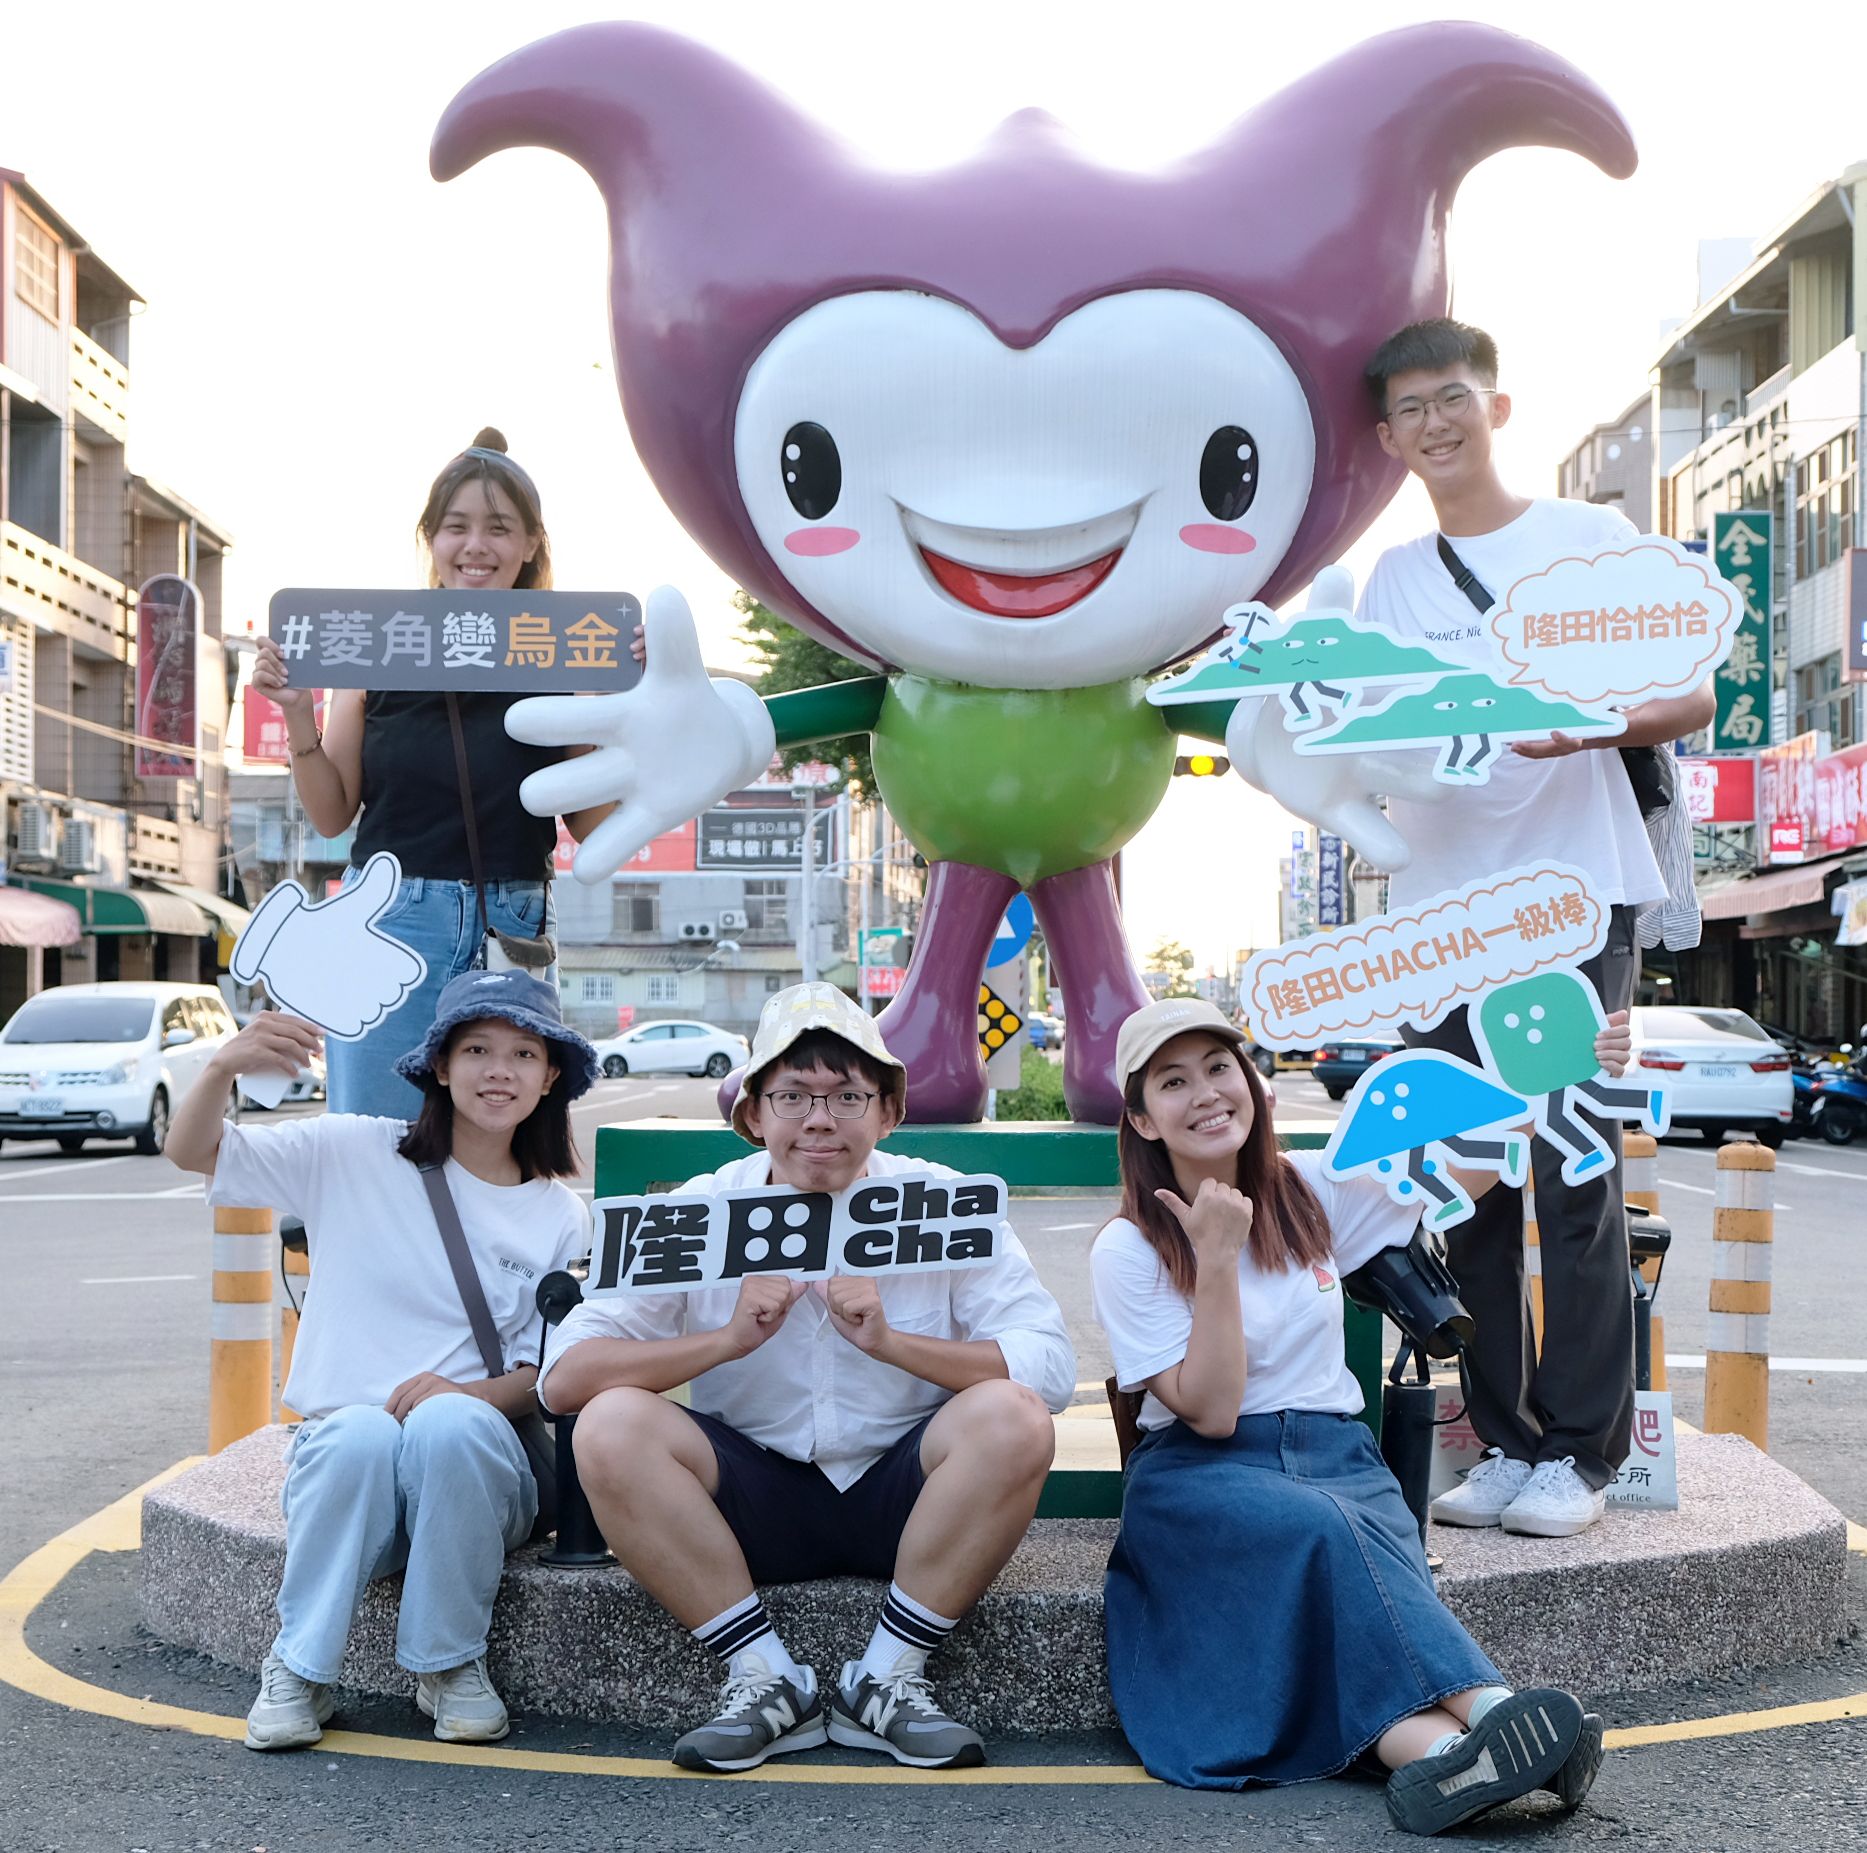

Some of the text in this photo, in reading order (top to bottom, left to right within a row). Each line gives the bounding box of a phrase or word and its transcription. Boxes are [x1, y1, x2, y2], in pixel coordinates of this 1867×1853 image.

[280, 609, 619, 669] #菱角變烏金
[1523, 600, 1709, 649] 隆田恰恰恰
[1266, 891, 1588, 1020] 隆田CHACHA一級棒
[594, 1191, 833, 1291] 隆田
[511, 1262, 535, 1280] BUTTER
[1619, 1493, 1652, 1502] office
